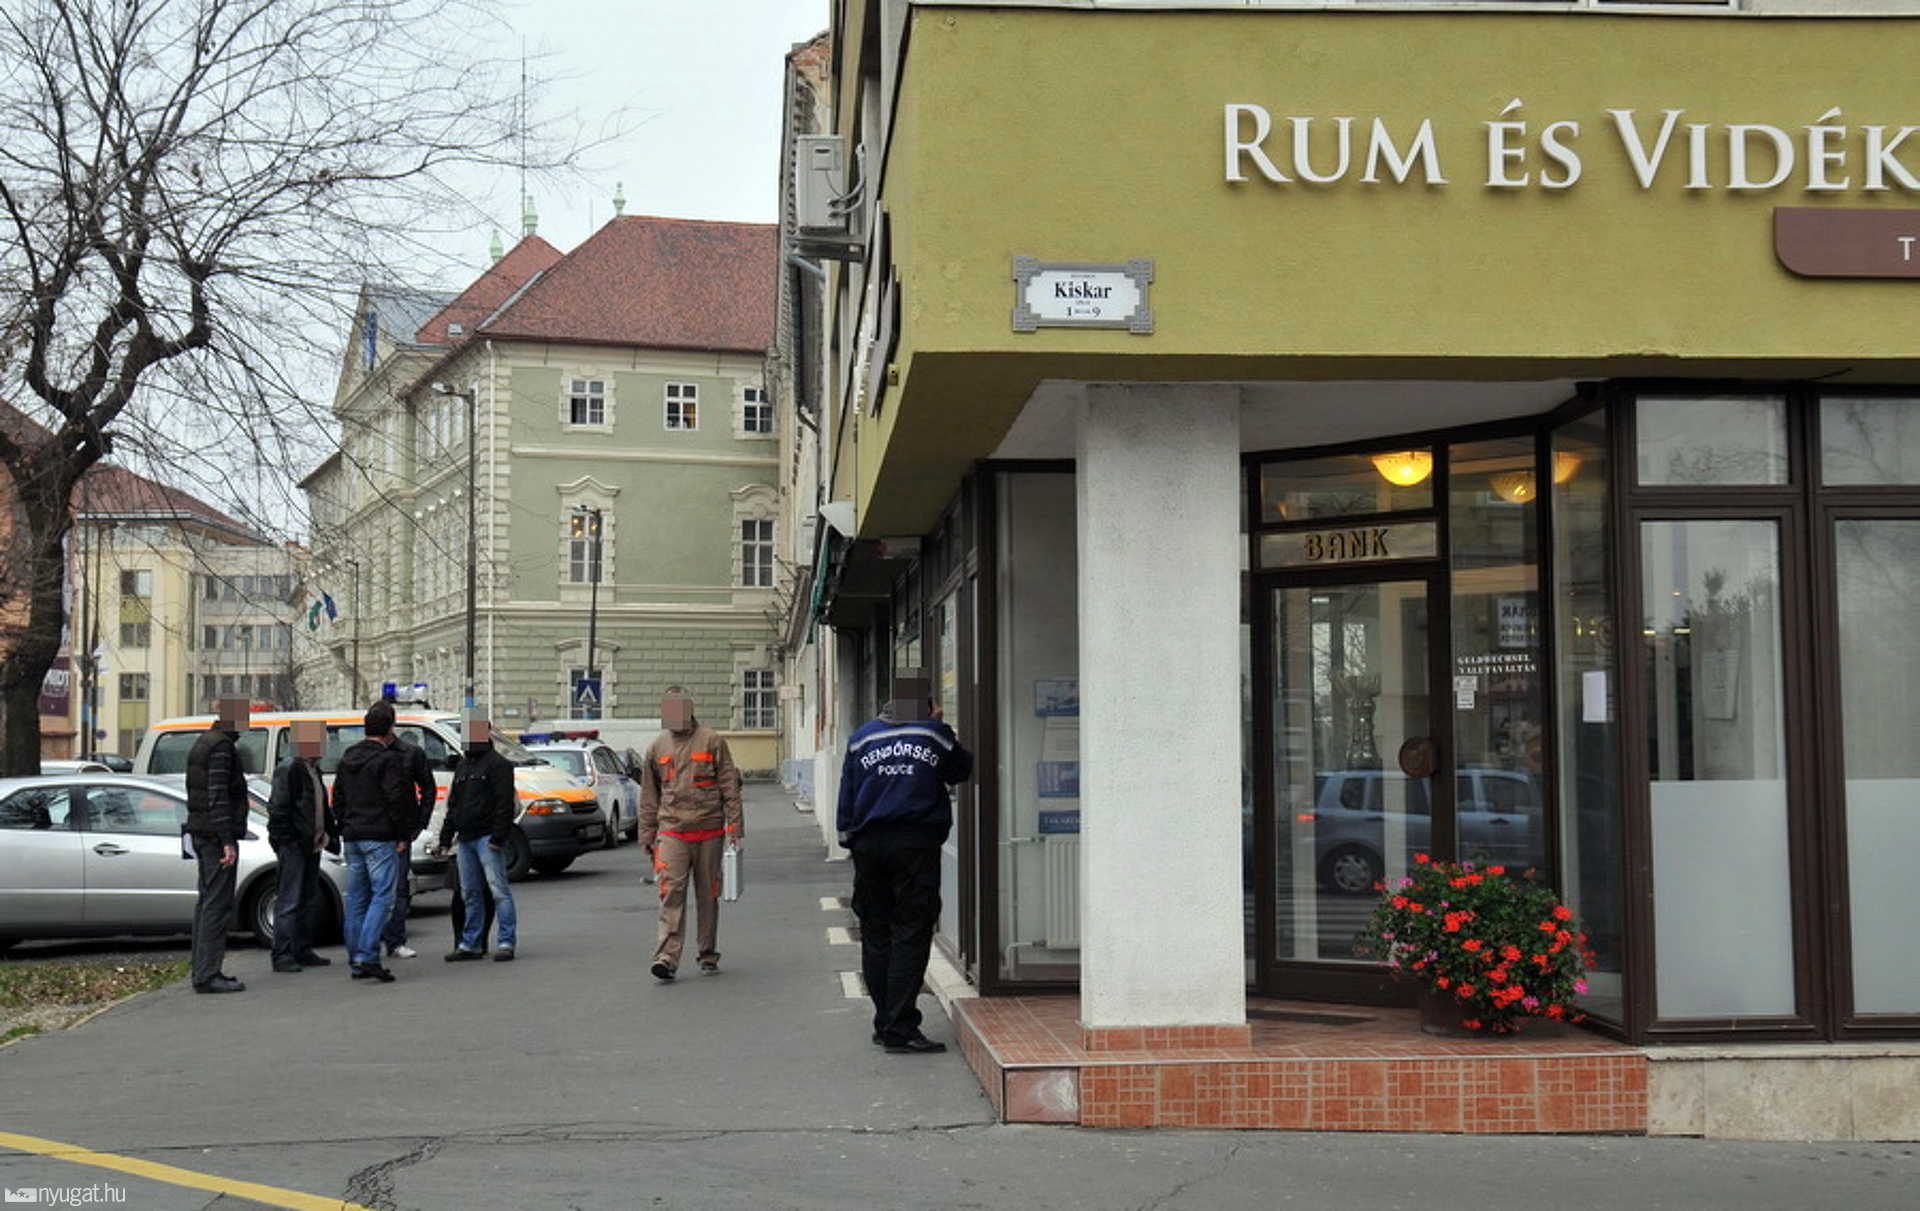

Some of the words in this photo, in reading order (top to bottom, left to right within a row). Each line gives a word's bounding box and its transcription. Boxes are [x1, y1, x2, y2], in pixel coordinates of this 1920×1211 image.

[1223, 103, 1449, 184] RUM
[1484, 98, 1583, 187] ÉS
[1055, 281, 1112, 299] Kiskar
[1304, 528, 1389, 560] BANK
[878, 764, 914, 776] POLICE
